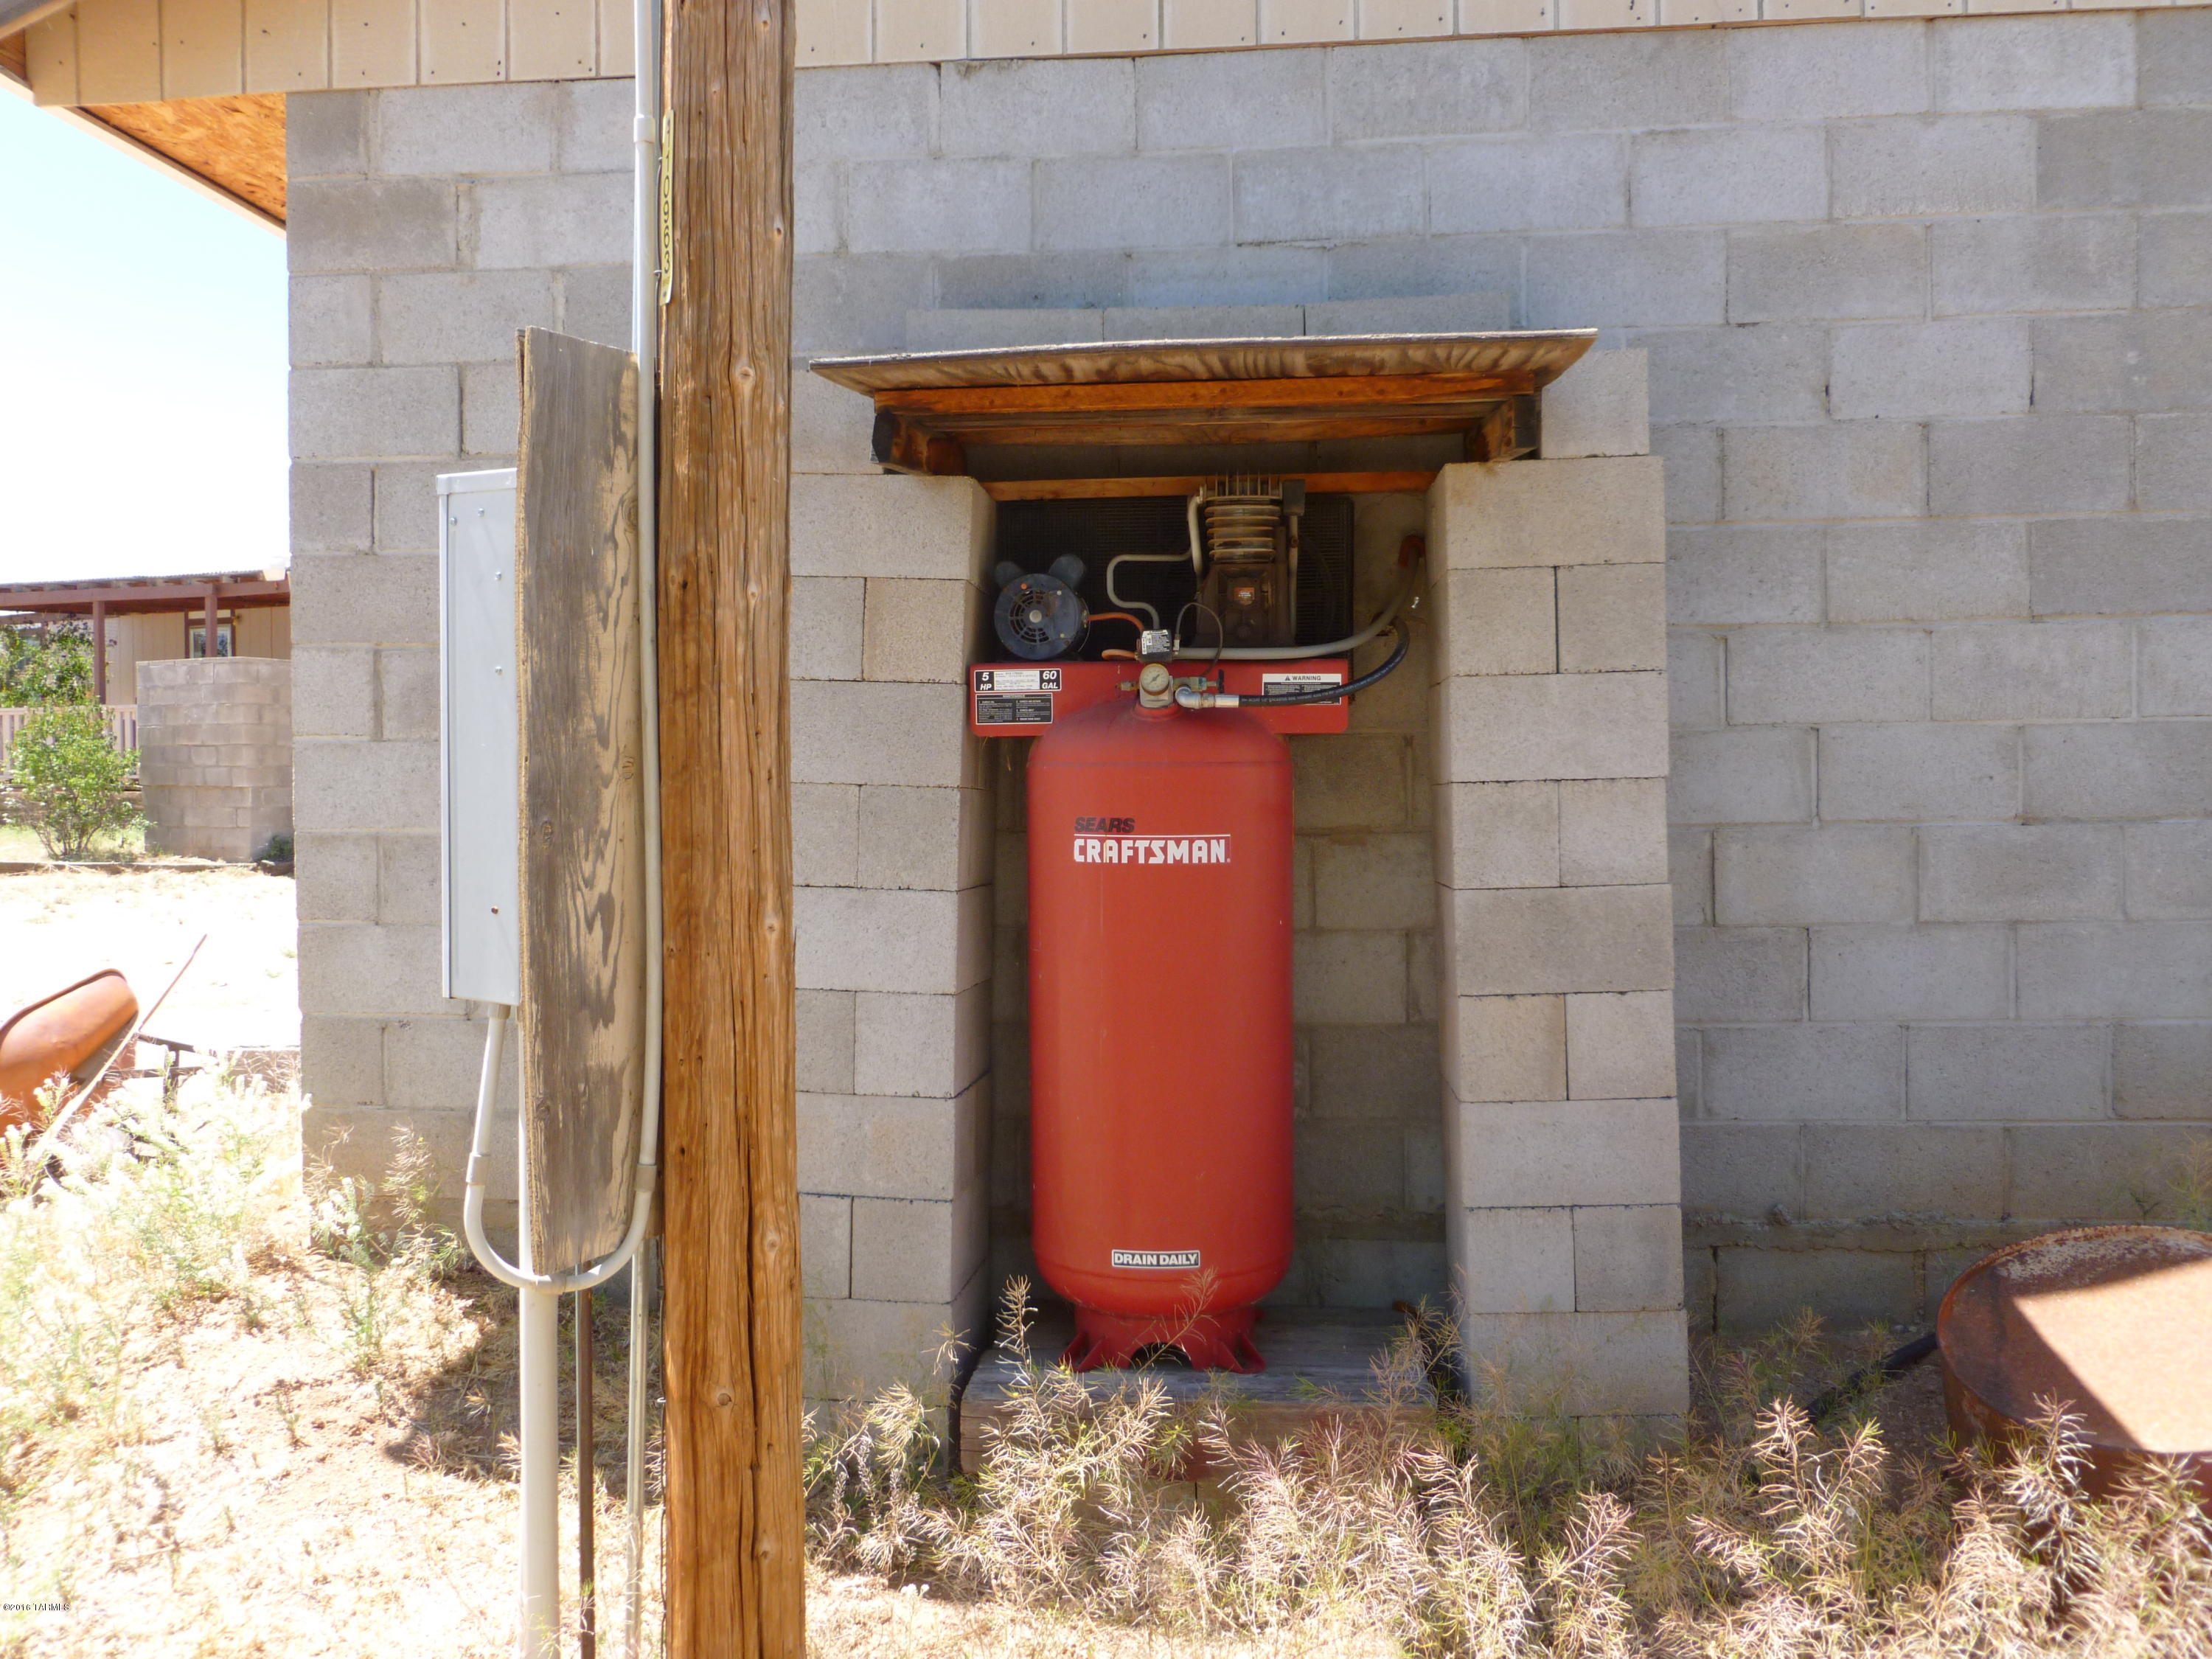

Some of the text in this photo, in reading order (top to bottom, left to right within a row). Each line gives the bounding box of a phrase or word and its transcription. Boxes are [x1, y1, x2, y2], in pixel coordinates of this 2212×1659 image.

[982, 672, 990, 681] 5
[1043, 671, 1057, 680] 60
[1074, 817, 1135, 833] SEARS
[1074, 838, 1225, 864] CRAFTSMAN
[1114, 1253, 1197, 1266] DRAIN DAILY
